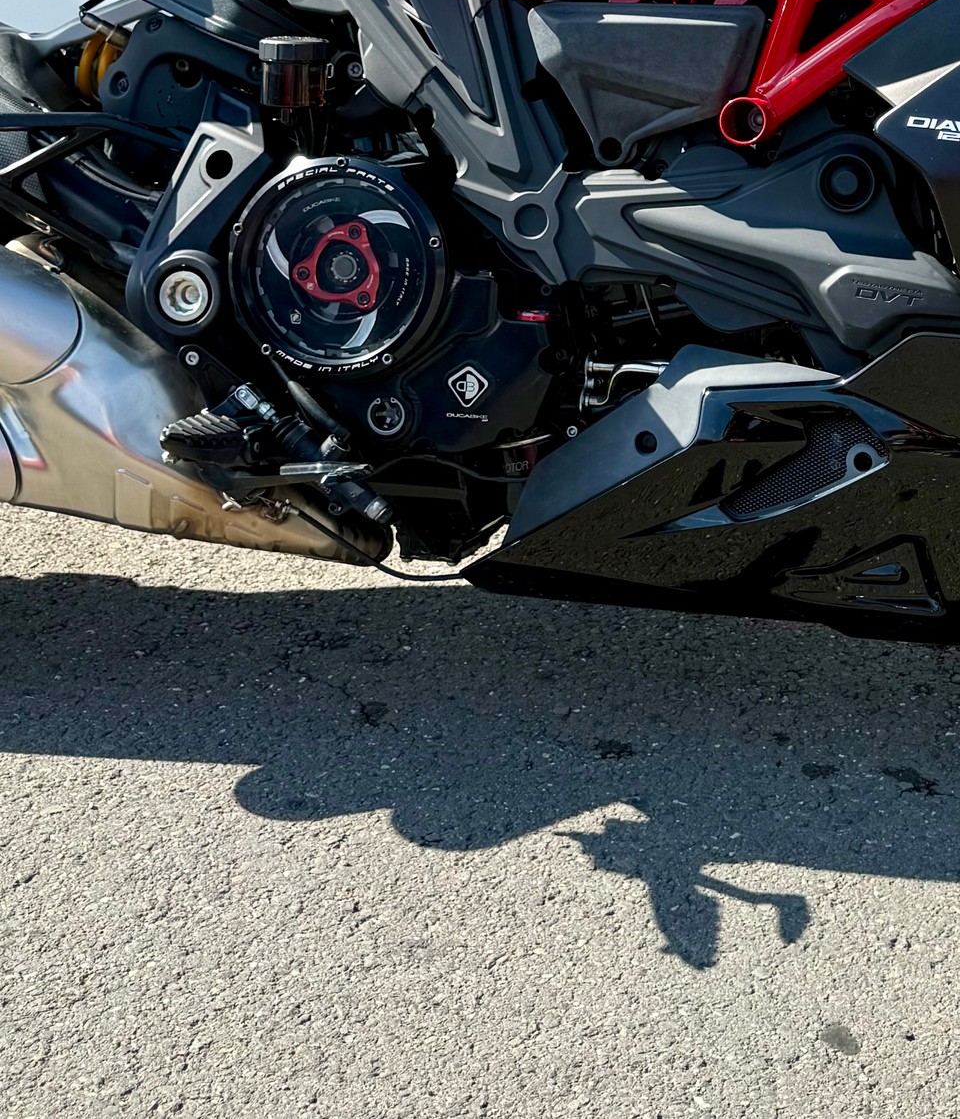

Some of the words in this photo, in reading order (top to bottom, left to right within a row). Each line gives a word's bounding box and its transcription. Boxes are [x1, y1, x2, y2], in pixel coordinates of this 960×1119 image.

[277, 166, 338, 191] SPECIAL
[345, 168, 395, 192] PARTS
[855, 287, 924, 307] DVT
[276, 349, 313, 370] MADE
[337, 355, 379, 373] ITALY
